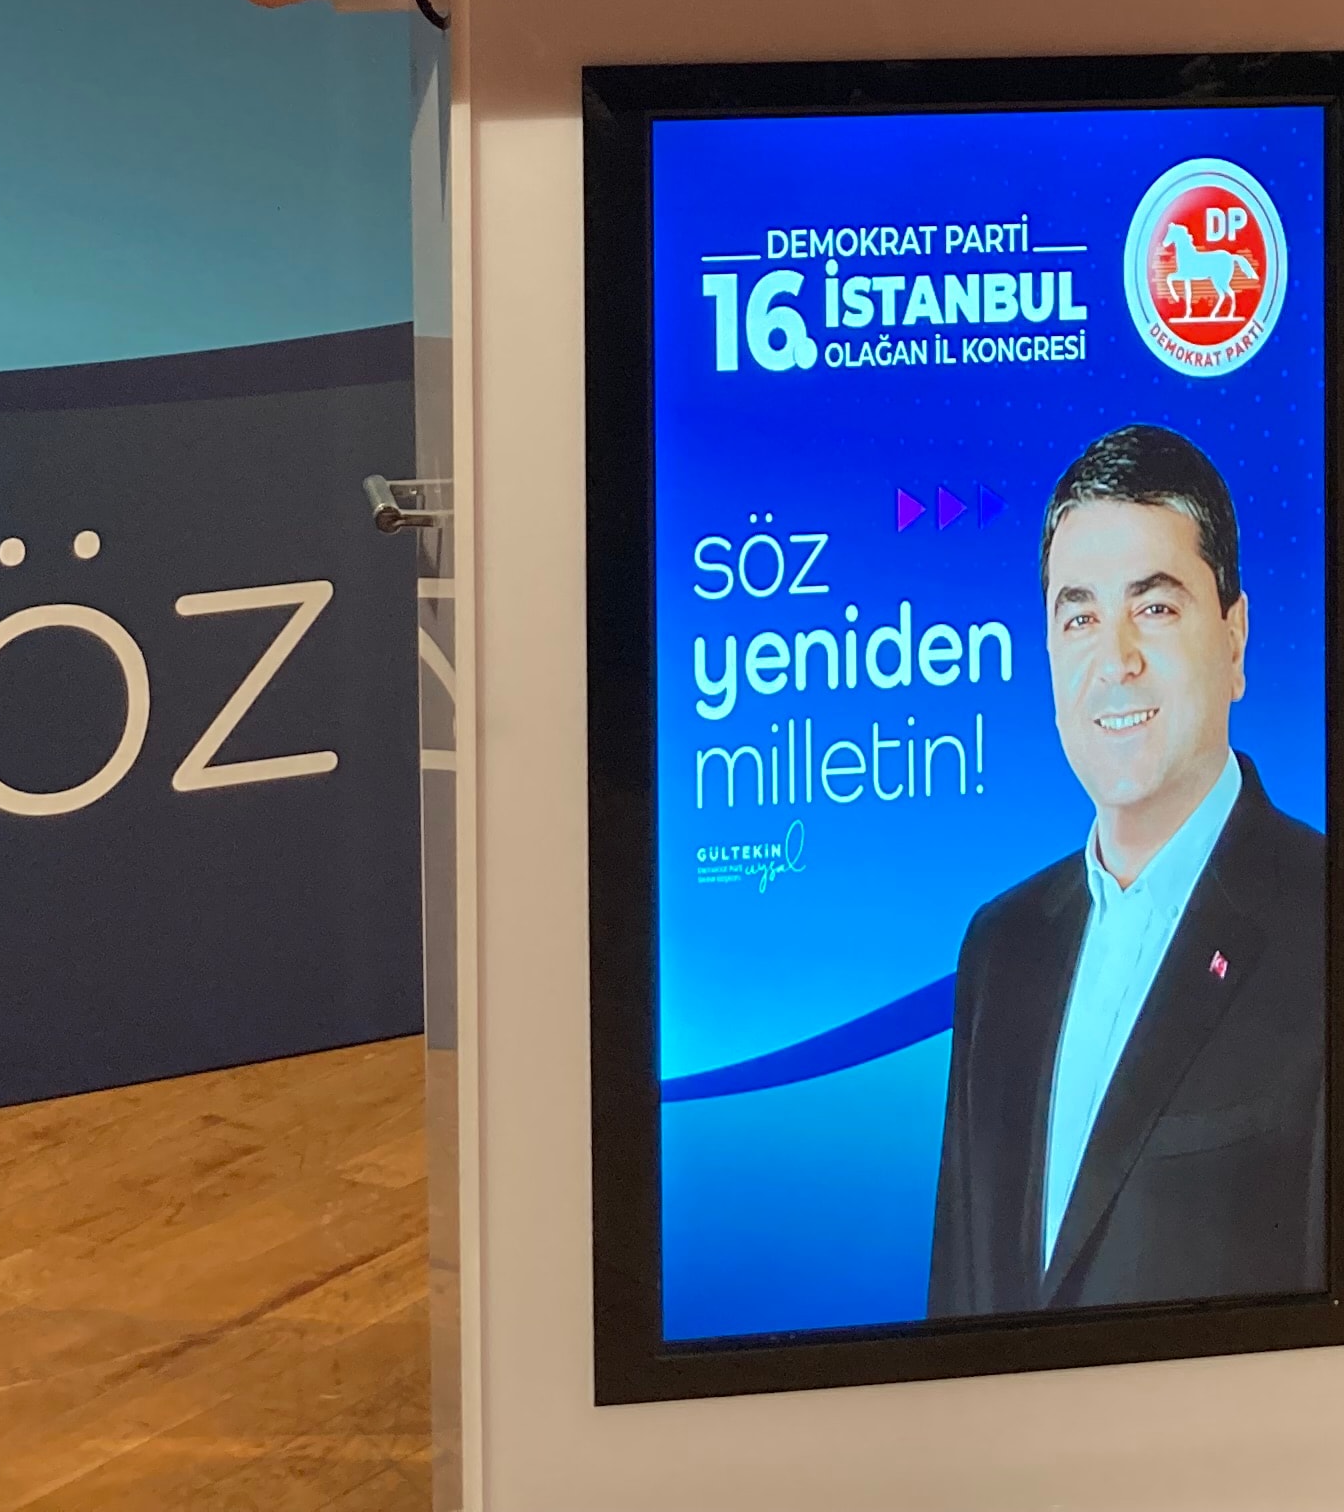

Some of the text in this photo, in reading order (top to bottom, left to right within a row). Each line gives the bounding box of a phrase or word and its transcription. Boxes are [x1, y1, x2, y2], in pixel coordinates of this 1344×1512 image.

[767, 214, 1028, 259] DEMOKRAT PARTİ
[1206, 207, 1248, 242] DP
[825, 259, 1088, 328] İSTANBUL
[824, 329, 1086, 369] OLAĞAN İL KONGRESİ
[1149, 319, 1264, 367] DEMOKRAT PARTİ
[694, 601, 1013, 720] yeniden
[696, 714, 984, 809] milletin!
